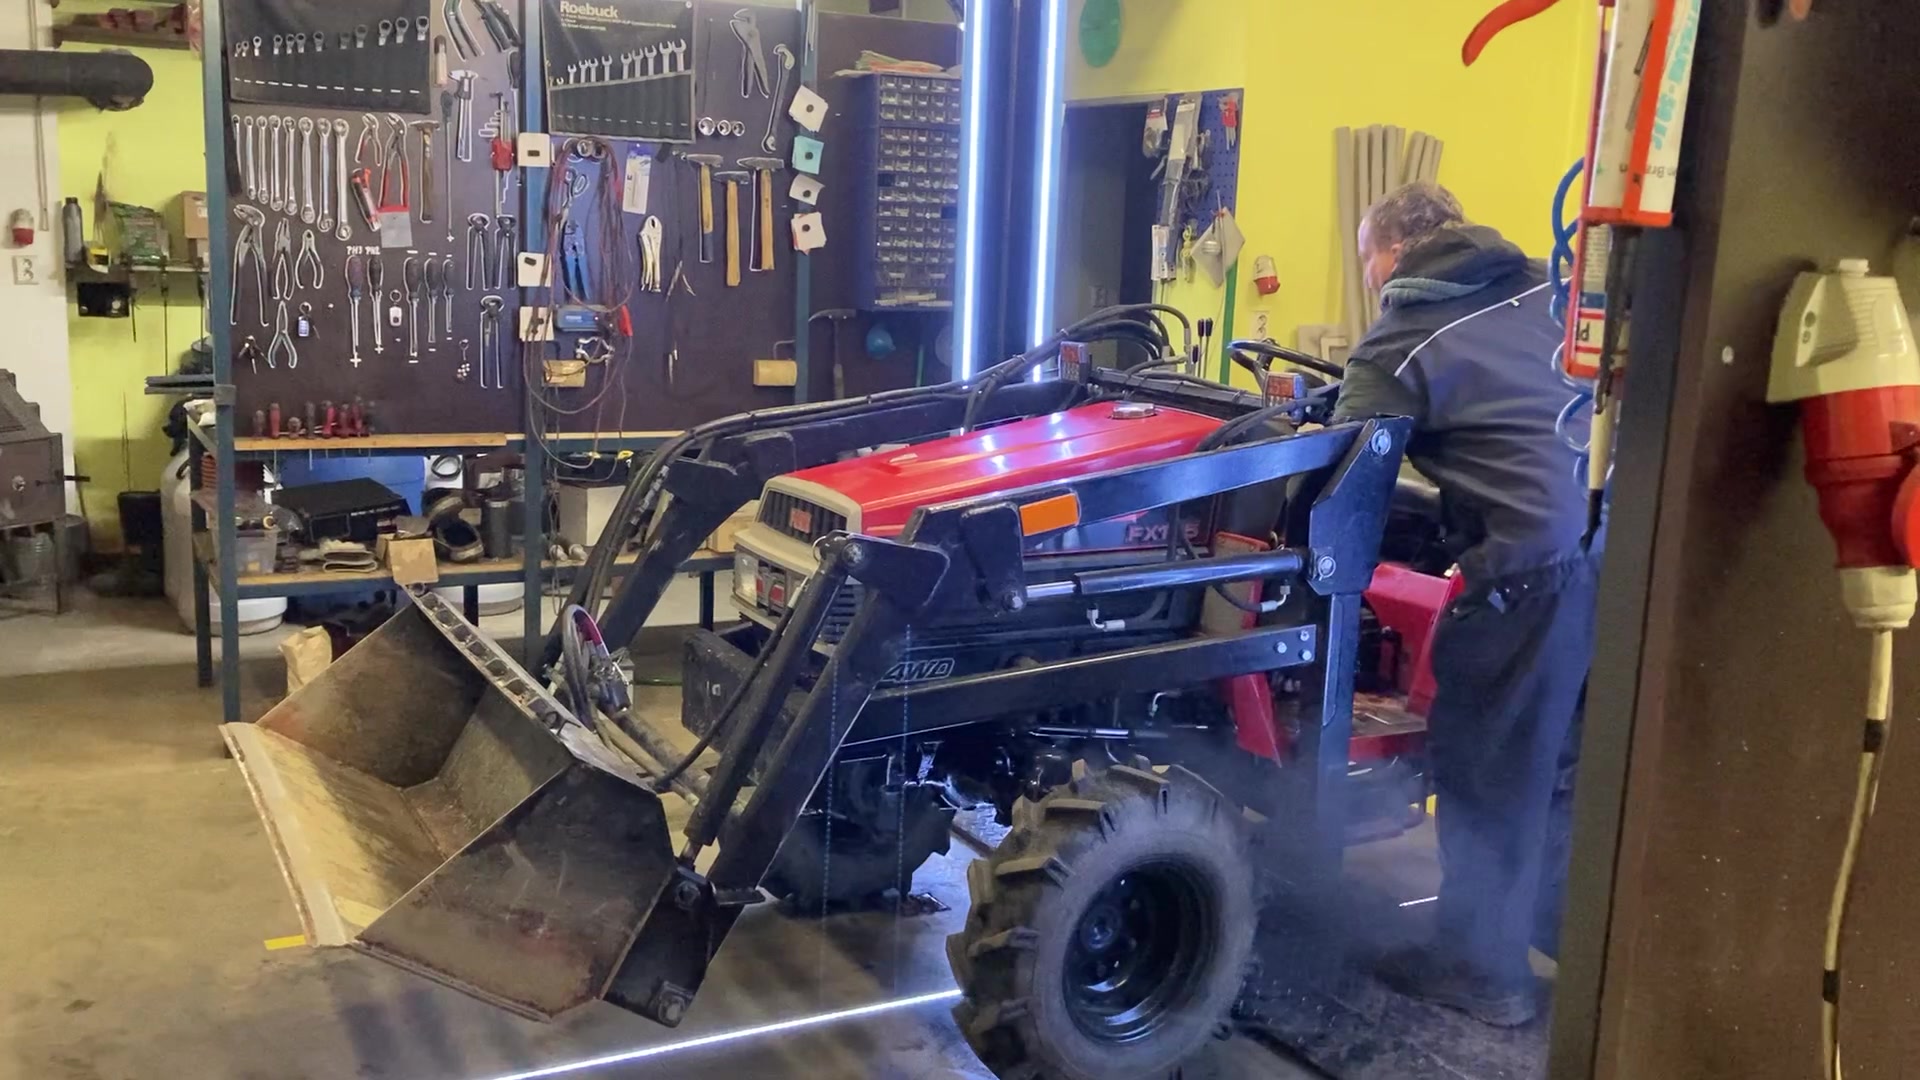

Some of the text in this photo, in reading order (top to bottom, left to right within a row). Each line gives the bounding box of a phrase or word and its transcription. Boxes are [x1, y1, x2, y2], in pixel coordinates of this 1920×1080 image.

[560, 1, 618, 18] Roebuck
[1127, 522, 1200, 542] FX15
[880, 657, 956, 684] 4WD
